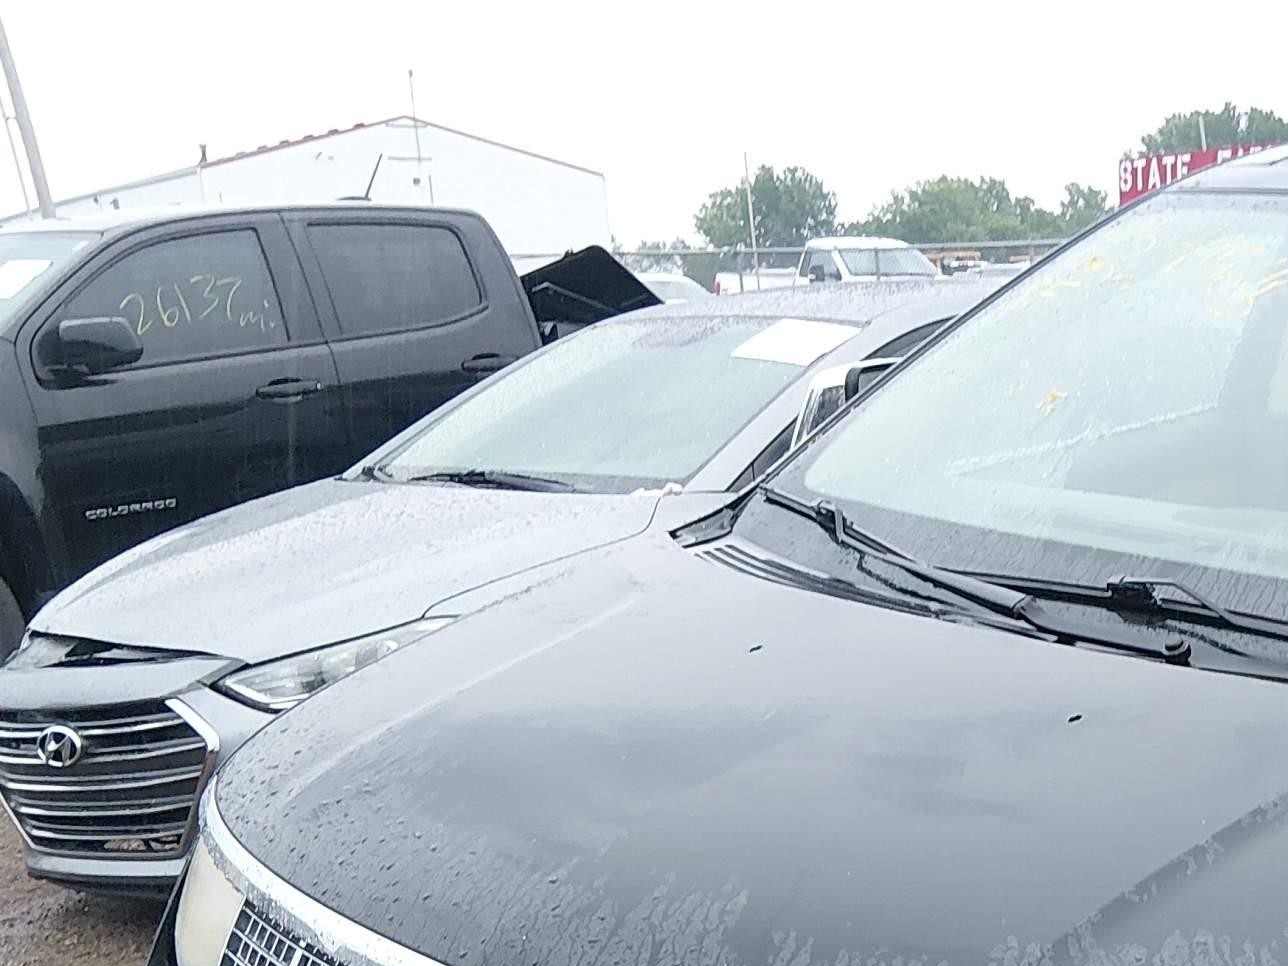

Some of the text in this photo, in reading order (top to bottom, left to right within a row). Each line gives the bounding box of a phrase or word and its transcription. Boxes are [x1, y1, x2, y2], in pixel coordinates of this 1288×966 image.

[1119, 152, 1192, 193] STATE
[119, 274, 242, 336] 26137
[85, 498, 177, 520] COLORADO
